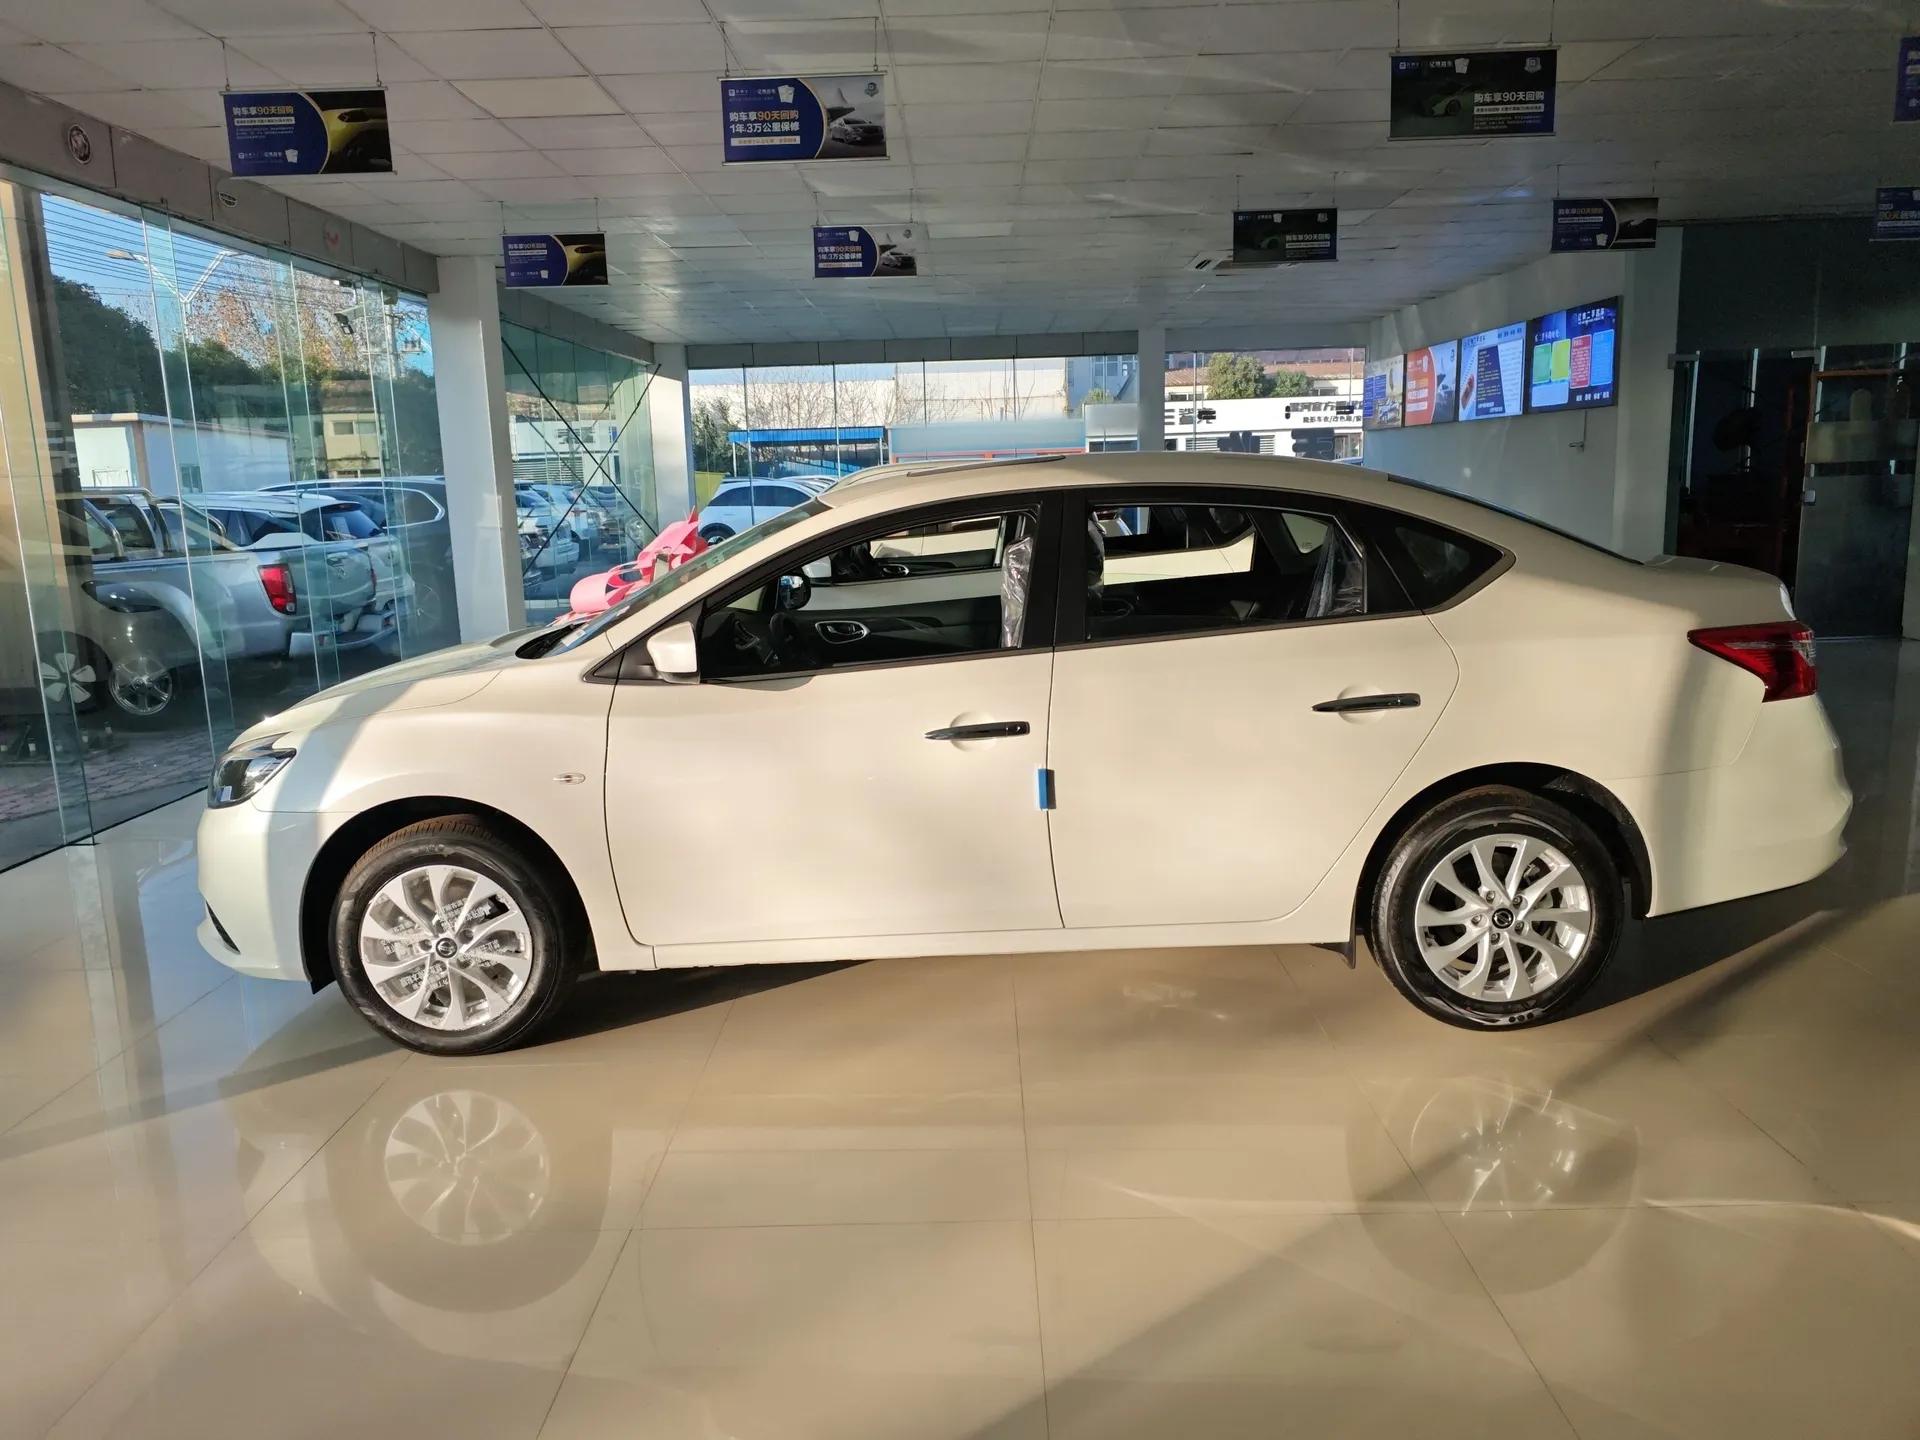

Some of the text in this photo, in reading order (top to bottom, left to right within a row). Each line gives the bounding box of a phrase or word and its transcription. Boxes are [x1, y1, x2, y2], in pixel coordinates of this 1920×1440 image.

[1474, 91, 1545, 103] 购车享90天回购
[729, 110, 799, 122] 购车享90天回购
